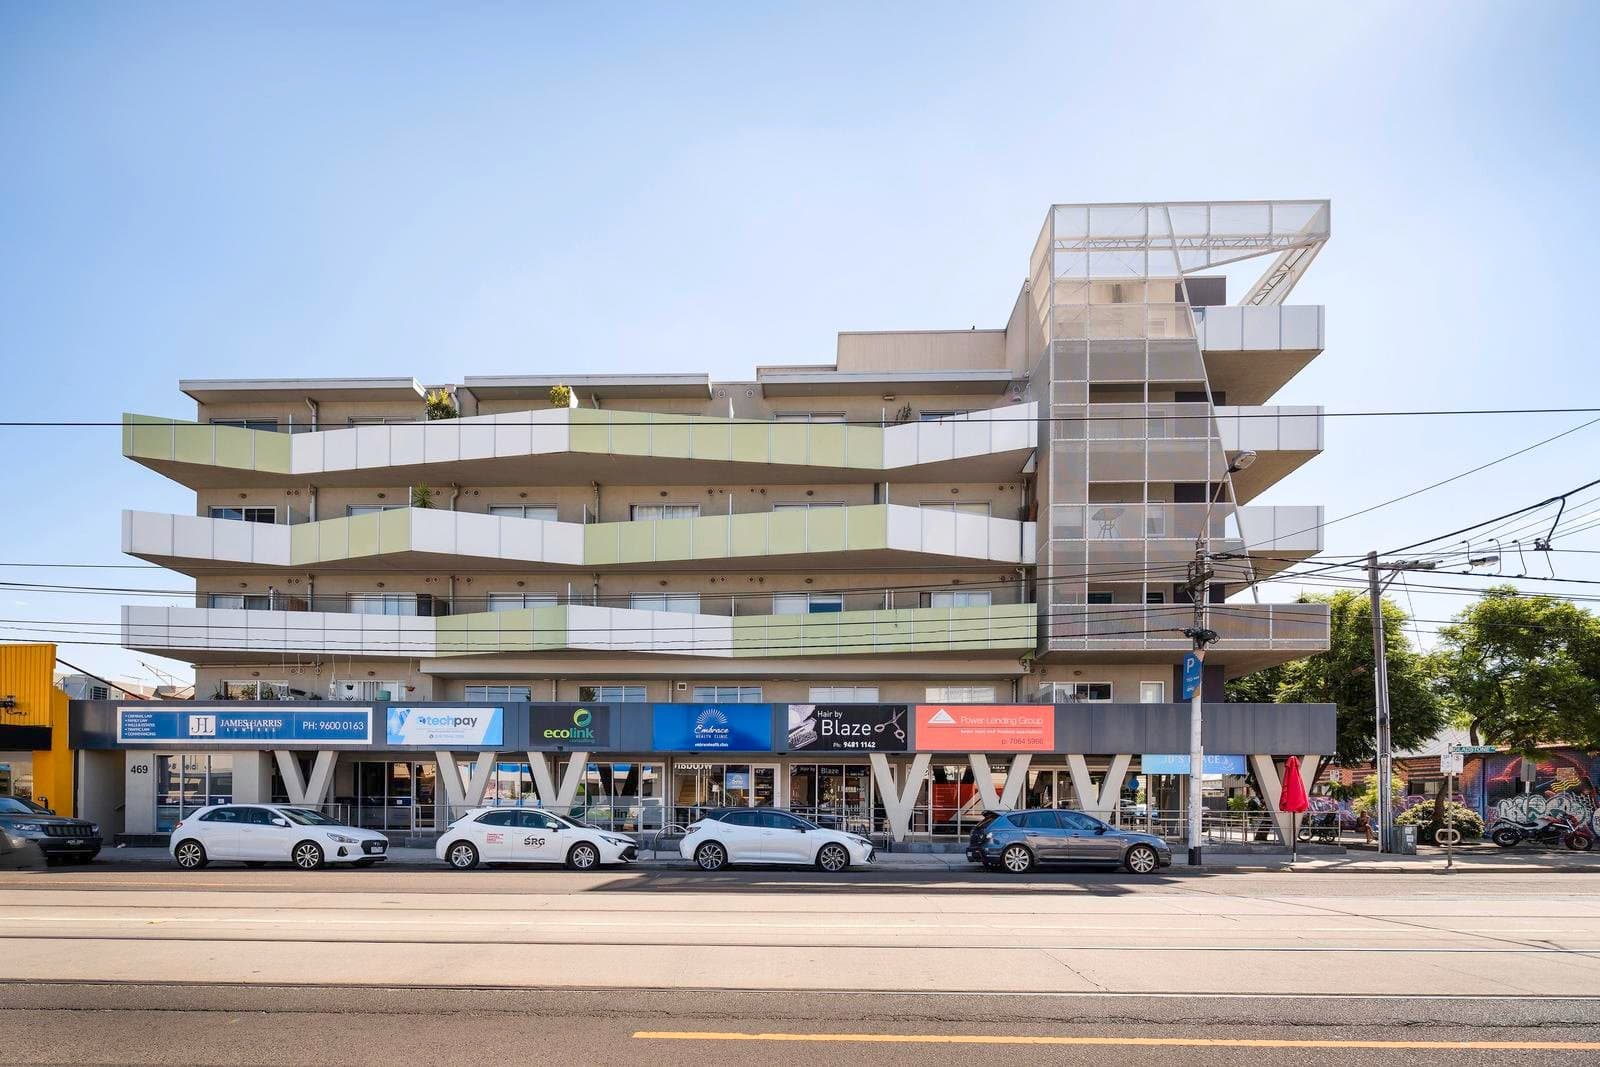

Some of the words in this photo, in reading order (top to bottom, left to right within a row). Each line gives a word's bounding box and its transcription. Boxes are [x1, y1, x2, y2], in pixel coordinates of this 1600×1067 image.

[1186, 657, 1195, 673] P
[834, 710, 843, 719] by
[220, 719, 247, 727] JAMES
[250, 719, 282, 727] HARRIS
[302, 721, 318, 730] PH:
[319, 721, 341, 730] 9600
[342, 721, 364, 730] 0163
[427, 715, 478, 728] techpay
[694, 724, 729, 734] Embrace
[821, 719, 872, 736] Blaze
[543, 727, 594, 739] ecolink
[130, 764, 149, 774] 469
[523, 836, 546, 846] SRG
